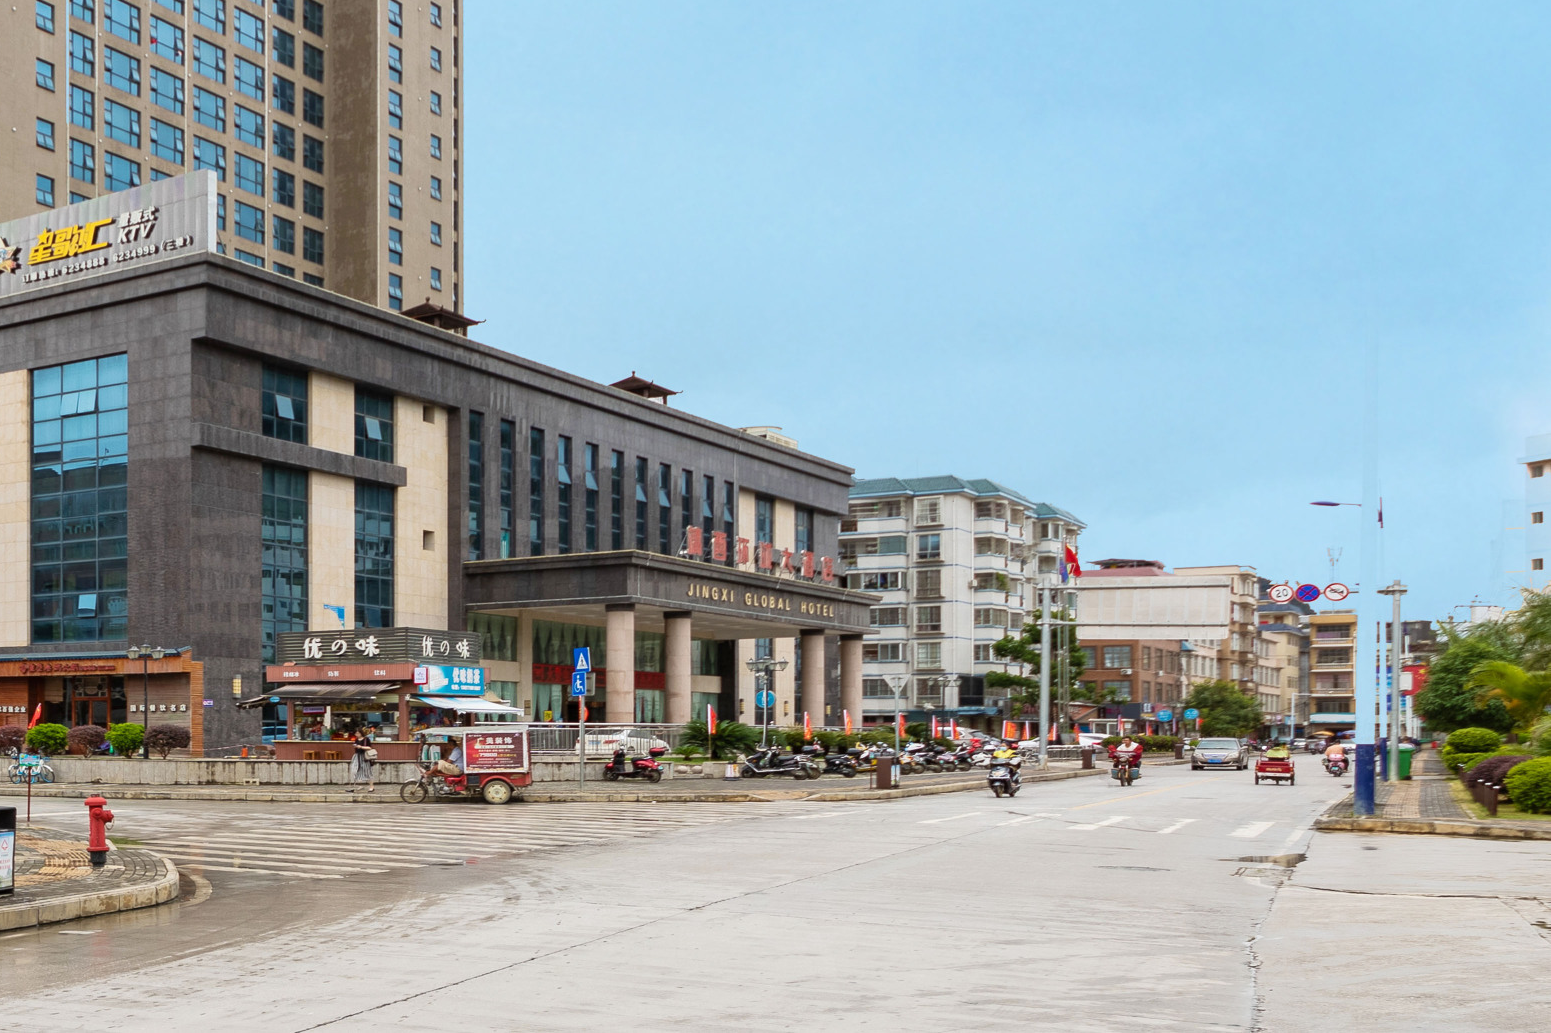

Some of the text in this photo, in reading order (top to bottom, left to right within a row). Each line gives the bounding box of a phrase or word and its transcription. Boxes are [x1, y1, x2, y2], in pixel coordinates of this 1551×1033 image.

[118, 221, 155, 244] KTV
[113, 245, 156, 262] 6234999
[687, 583, 835, 617] JINGXI GLOBAL HOTEL
[1275, 587, 1289, 598] 20
[303, 635, 380, 660] 优の味
[421, 635, 470, 659] 优の味
